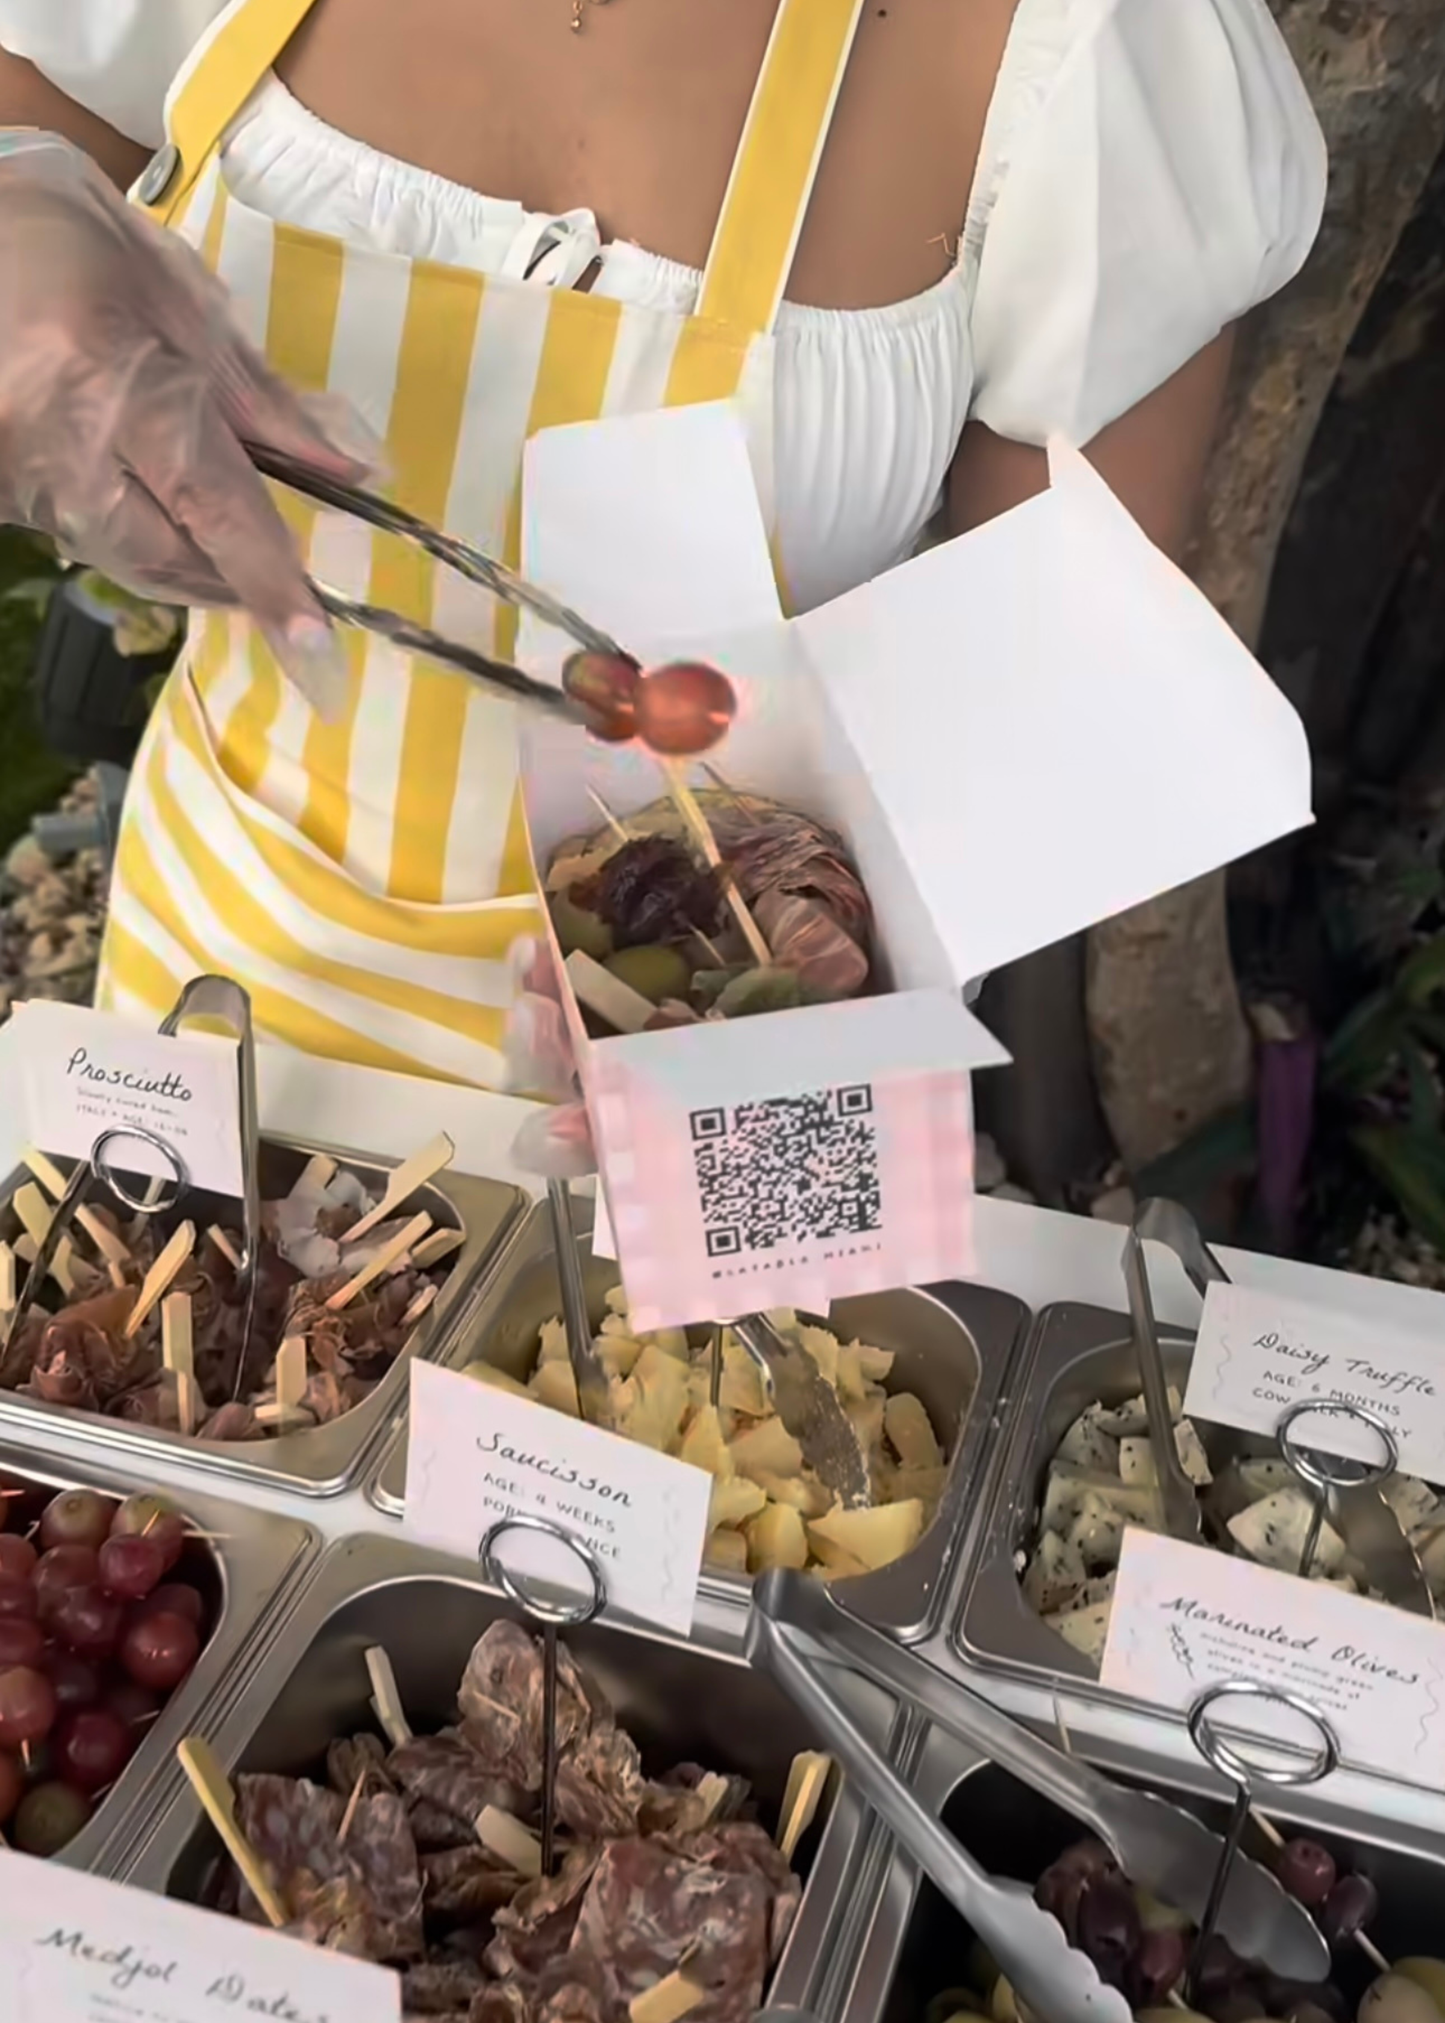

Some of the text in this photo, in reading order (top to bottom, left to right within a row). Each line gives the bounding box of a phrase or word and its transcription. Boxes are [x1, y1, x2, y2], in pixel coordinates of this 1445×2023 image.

[66, 1047, 192, 1102] Prosciutto
[823, 1242, 882, 1260] MIAMI
[1252, 1332, 1437, 1397] Daisy Truffle
[1311, 1383, 1321, 1393] 6
[1329, 1389, 1401, 1416] MONTHS
[476, 1432, 632, 1508] Saucisson
[556, 1501, 616, 1534] WEEKS
[1159, 1596, 1421, 1685] Marinated Olives
[36, 1929, 178, 1988] Medjol
